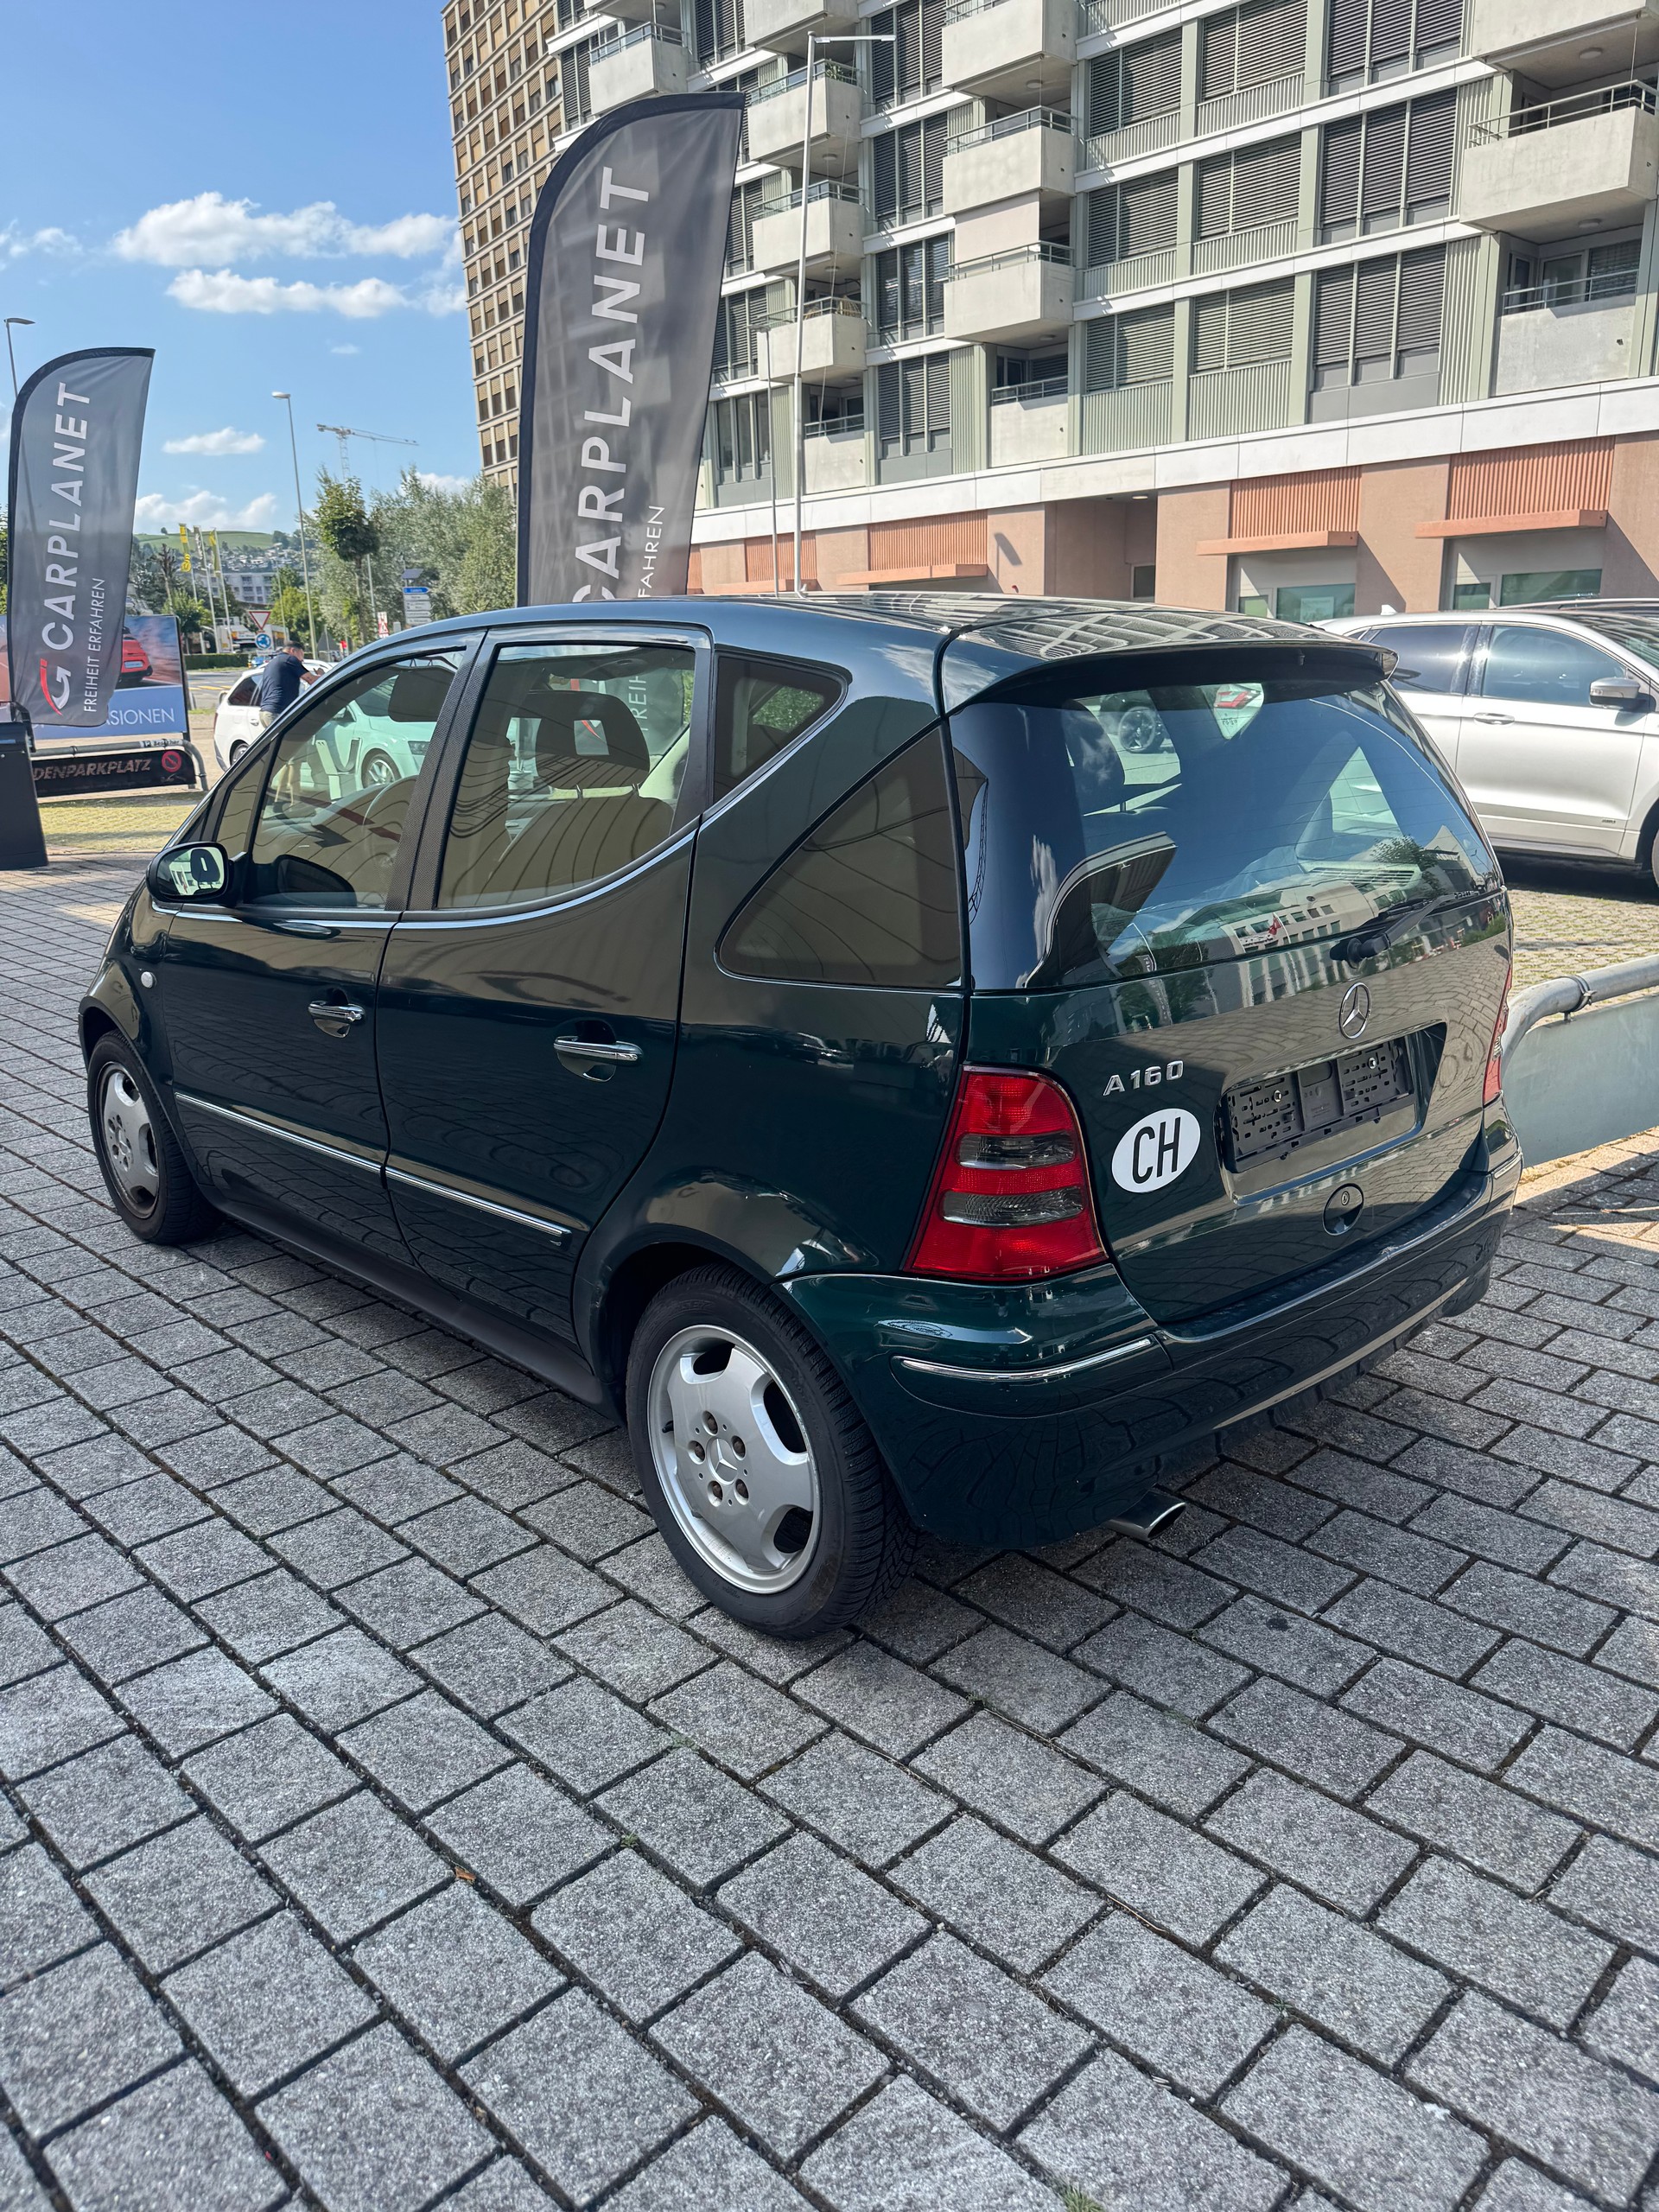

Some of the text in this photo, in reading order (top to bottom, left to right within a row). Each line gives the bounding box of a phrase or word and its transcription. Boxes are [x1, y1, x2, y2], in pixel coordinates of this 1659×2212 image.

[41, 381, 91, 651] CARPLANET
[84, 577, 105, 712] FREIHEIT ERFAHREN
[1132, 1116, 1181, 1185] CH
